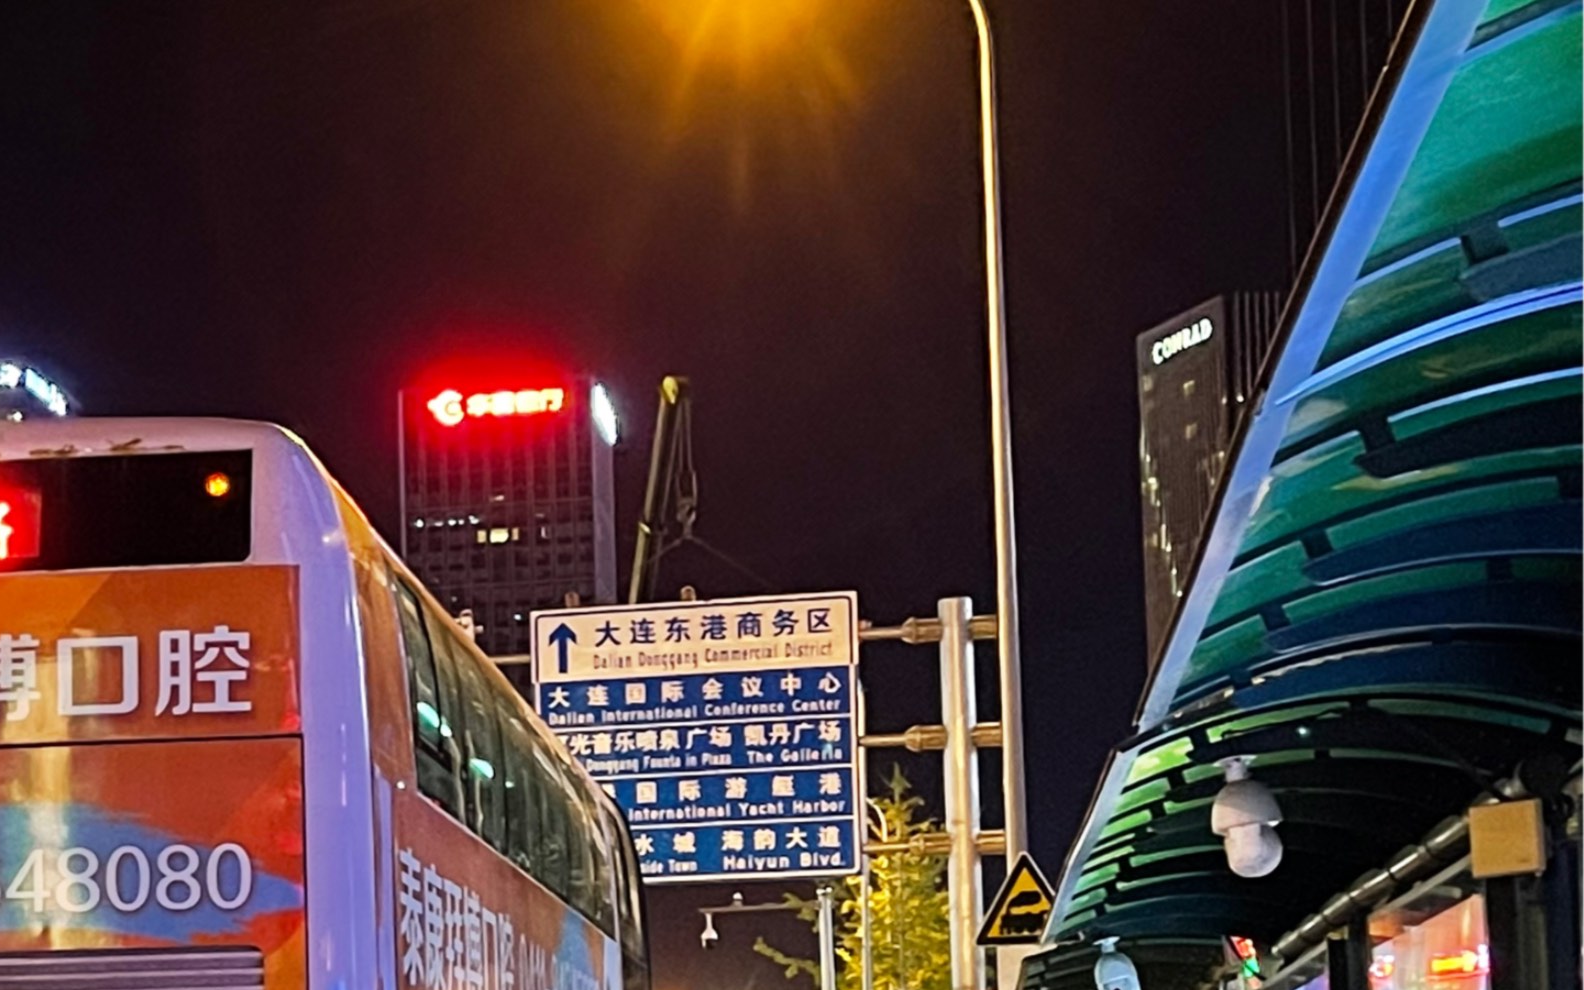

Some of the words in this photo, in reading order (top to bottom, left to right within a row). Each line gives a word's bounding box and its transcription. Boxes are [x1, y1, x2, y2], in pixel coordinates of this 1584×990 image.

[594, 607, 833, 648] 大连东港商务区
[593, 654, 632, 669] Dalian
[638, 650, 698, 669] Donggang
[705, 644, 778, 663] Commercial
[785, 642, 832, 658] District
[547, 671, 842, 709] 大连国际会议中心
[548, 711, 595, 726] Dalian
[601, 704, 697, 722] International
[704, 702, 785, 716] Conference
[792, 699, 841, 712] Center
[747, 750, 774, 764] The
[602, 772, 842, 804] 国际游艇港
[629, 802, 731, 821] International
[738, 800, 784, 817] Yacht
[792, 799, 846, 814] Harbor
[721, 826, 842, 852] 海韵大道
[723, 853, 790, 871] Haiyun
[799, 851, 846, 868] Blvd.
